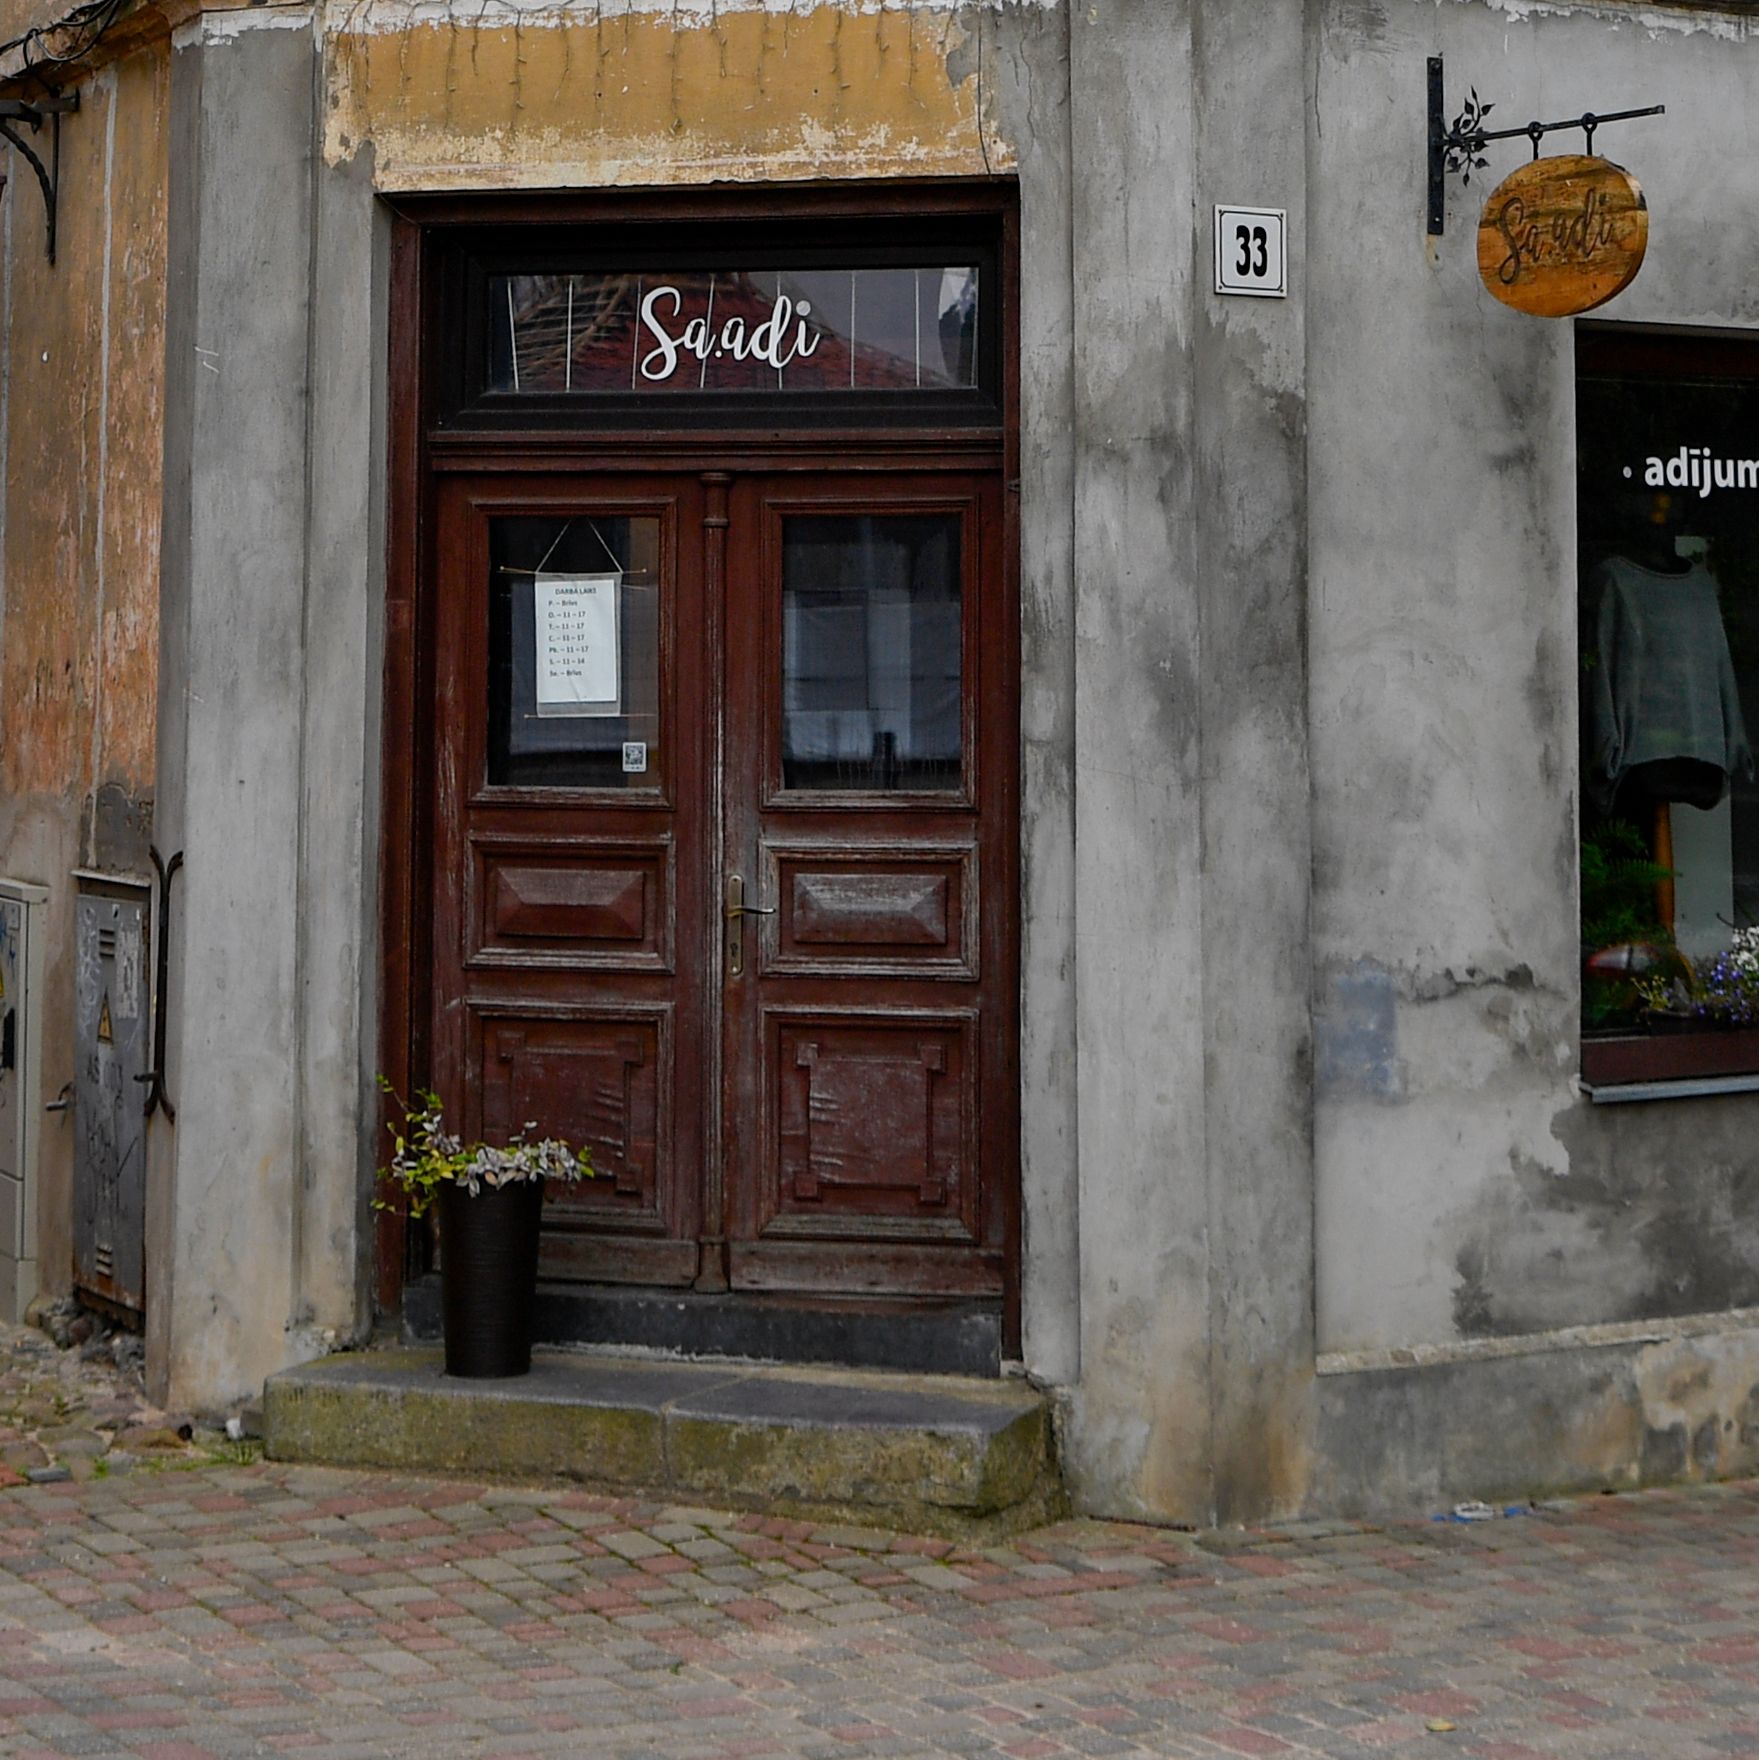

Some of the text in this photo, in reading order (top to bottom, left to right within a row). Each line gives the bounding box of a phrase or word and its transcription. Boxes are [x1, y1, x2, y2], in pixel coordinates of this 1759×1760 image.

[1236, 225, 1268, 277] 33
[641, 286, 820, 380] Sa.adi
[555, 587, 578, 595] DARBA
